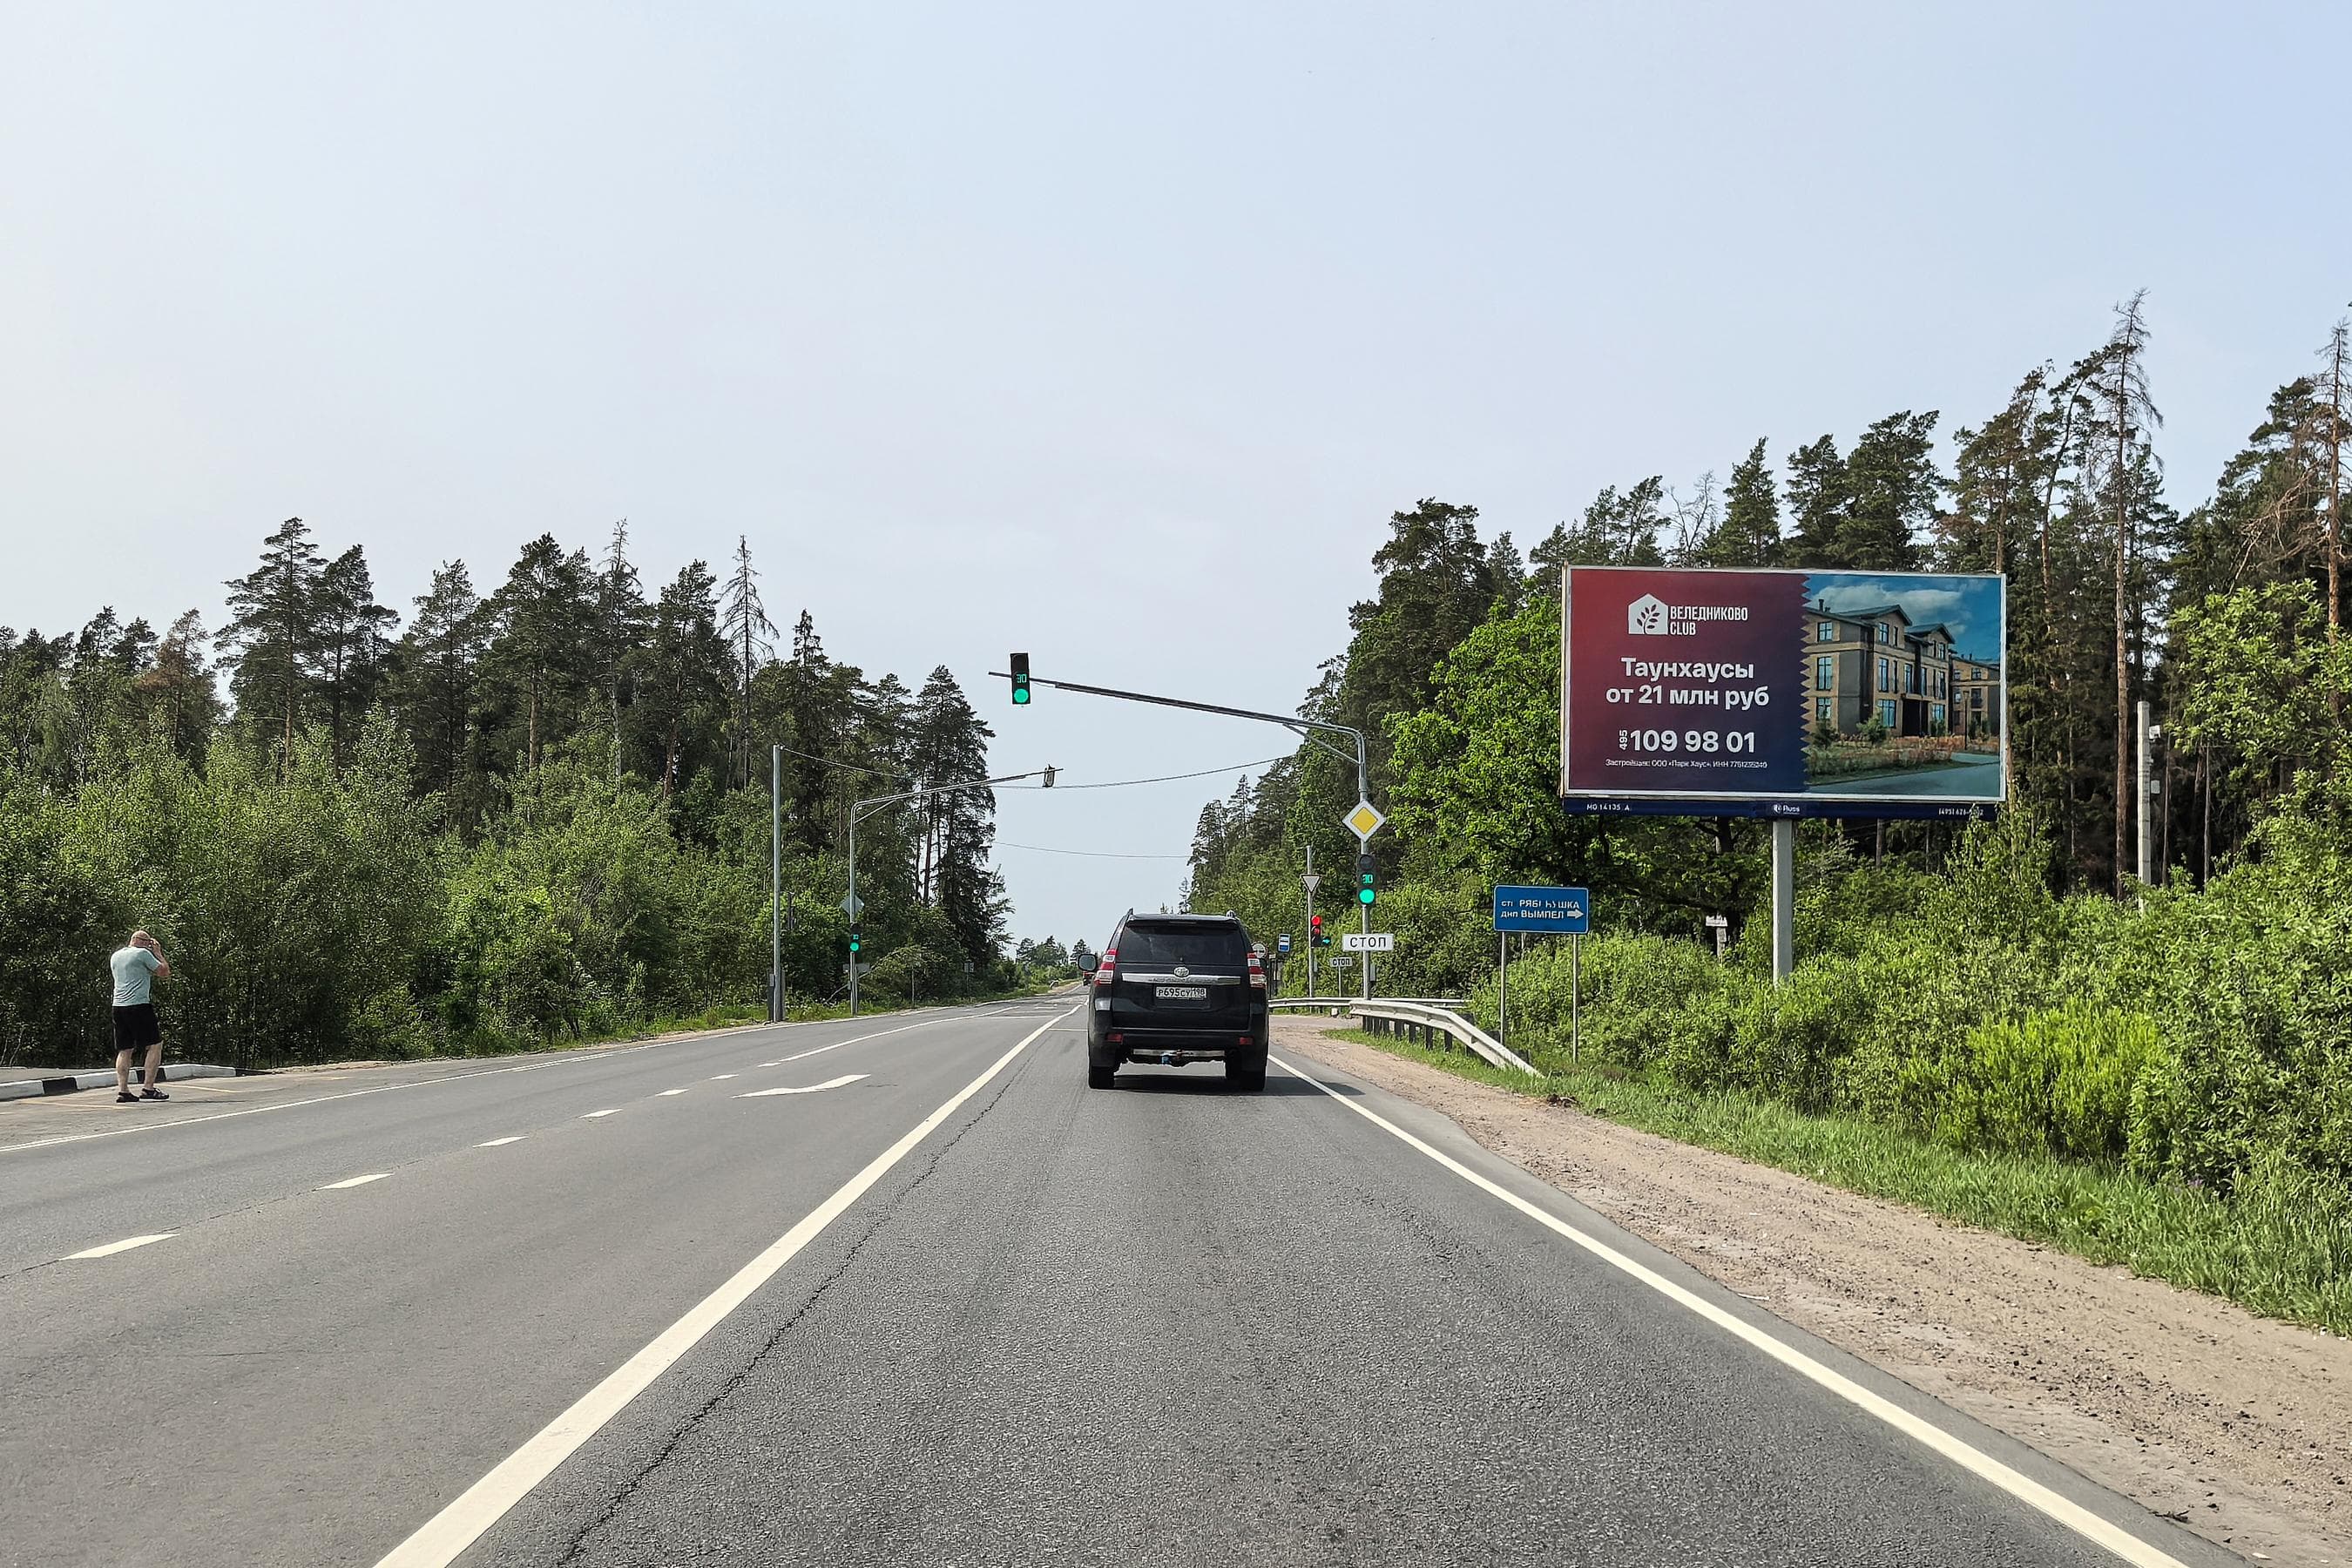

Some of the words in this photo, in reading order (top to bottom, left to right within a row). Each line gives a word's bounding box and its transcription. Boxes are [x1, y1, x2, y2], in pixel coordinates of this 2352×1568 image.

[1670, 605, 1748, 622] ВЕЛЕДНИКОВО
[1670, 622, 1696, 636] CLUB
[1620, 657, 1754, 683] Таунхаусы
[1605, 687, 1634, 704] от
[1638, 685, 1663, 705] 21
[1669, 688, 1719, 706] млн
[1725, 686, 1769, 711] руб
[1619, 729, 1628, 751] 495
[1630, 729, 1678, 753] 109
[1685, 730, 1720, 754] 98
[1726, 731, 1755, 754] 01
[1651, 759, 1667, 768] ООО
[1520, 909, 1565, 919] ВЫМПЕЛ
[1349, 936, 1387, 948] СТОП
